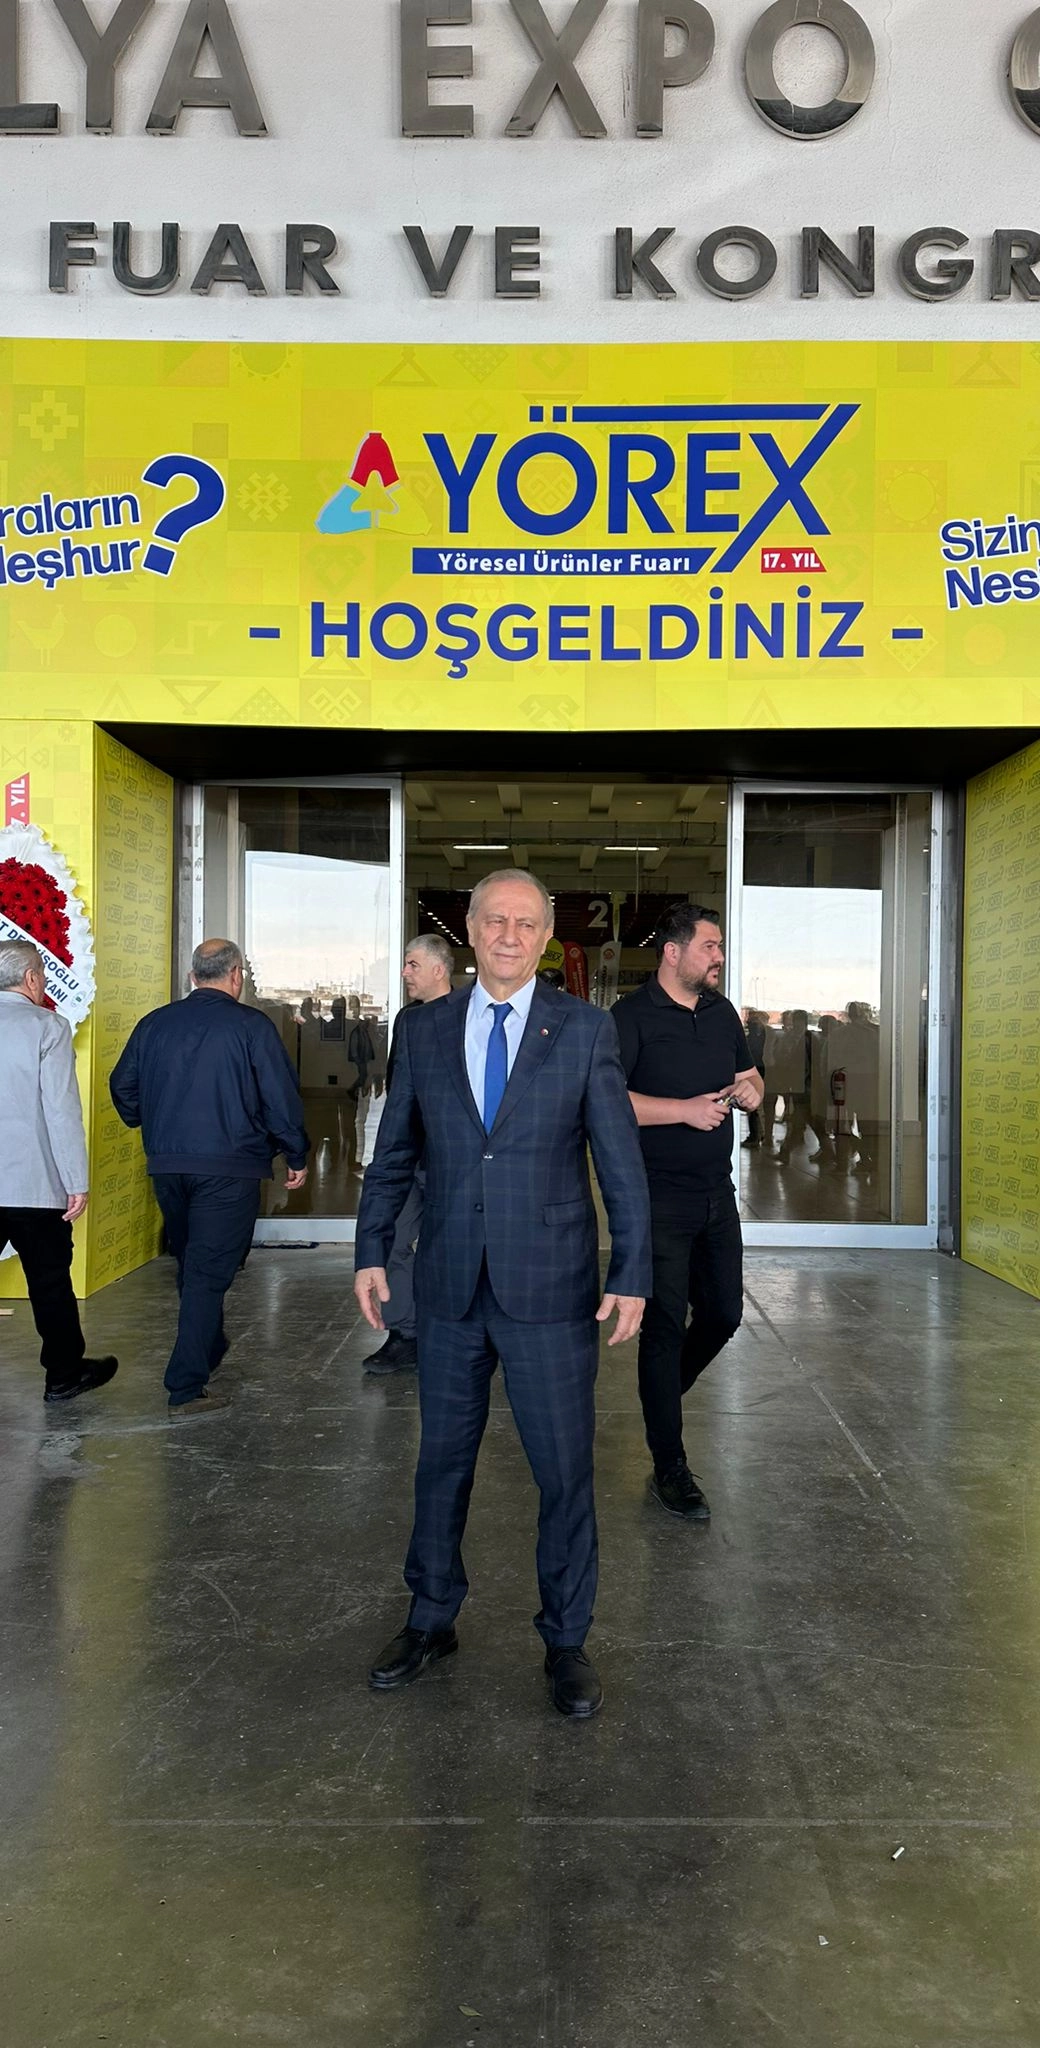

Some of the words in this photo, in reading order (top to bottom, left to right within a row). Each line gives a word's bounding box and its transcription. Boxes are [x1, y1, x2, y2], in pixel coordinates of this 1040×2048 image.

[401, 0, 874, 140] EXPO
[48, 221, 341, 297] FUAR
[402, 225, 541, 299] VE
[614, 226, 1040, 303] KONGR
[423, 403, 861, 573] YÖREX
[0, 540, 140, 590] eşhur
[438, 551, 525, 573] Yöresel
[533, 550, 623, 573] Ürünler
[630, 551, 691, 572] Fuarı
[763, 552, 786, 569] 17.
[791, 552, 820, 569] YIL
[945, 565, 1040, 609] Nes
[310, 585, 864, 680] HOŞGELDİNİZ
[10, 778, 26, 810] YIL
[586, 900, 609, 928] 2
